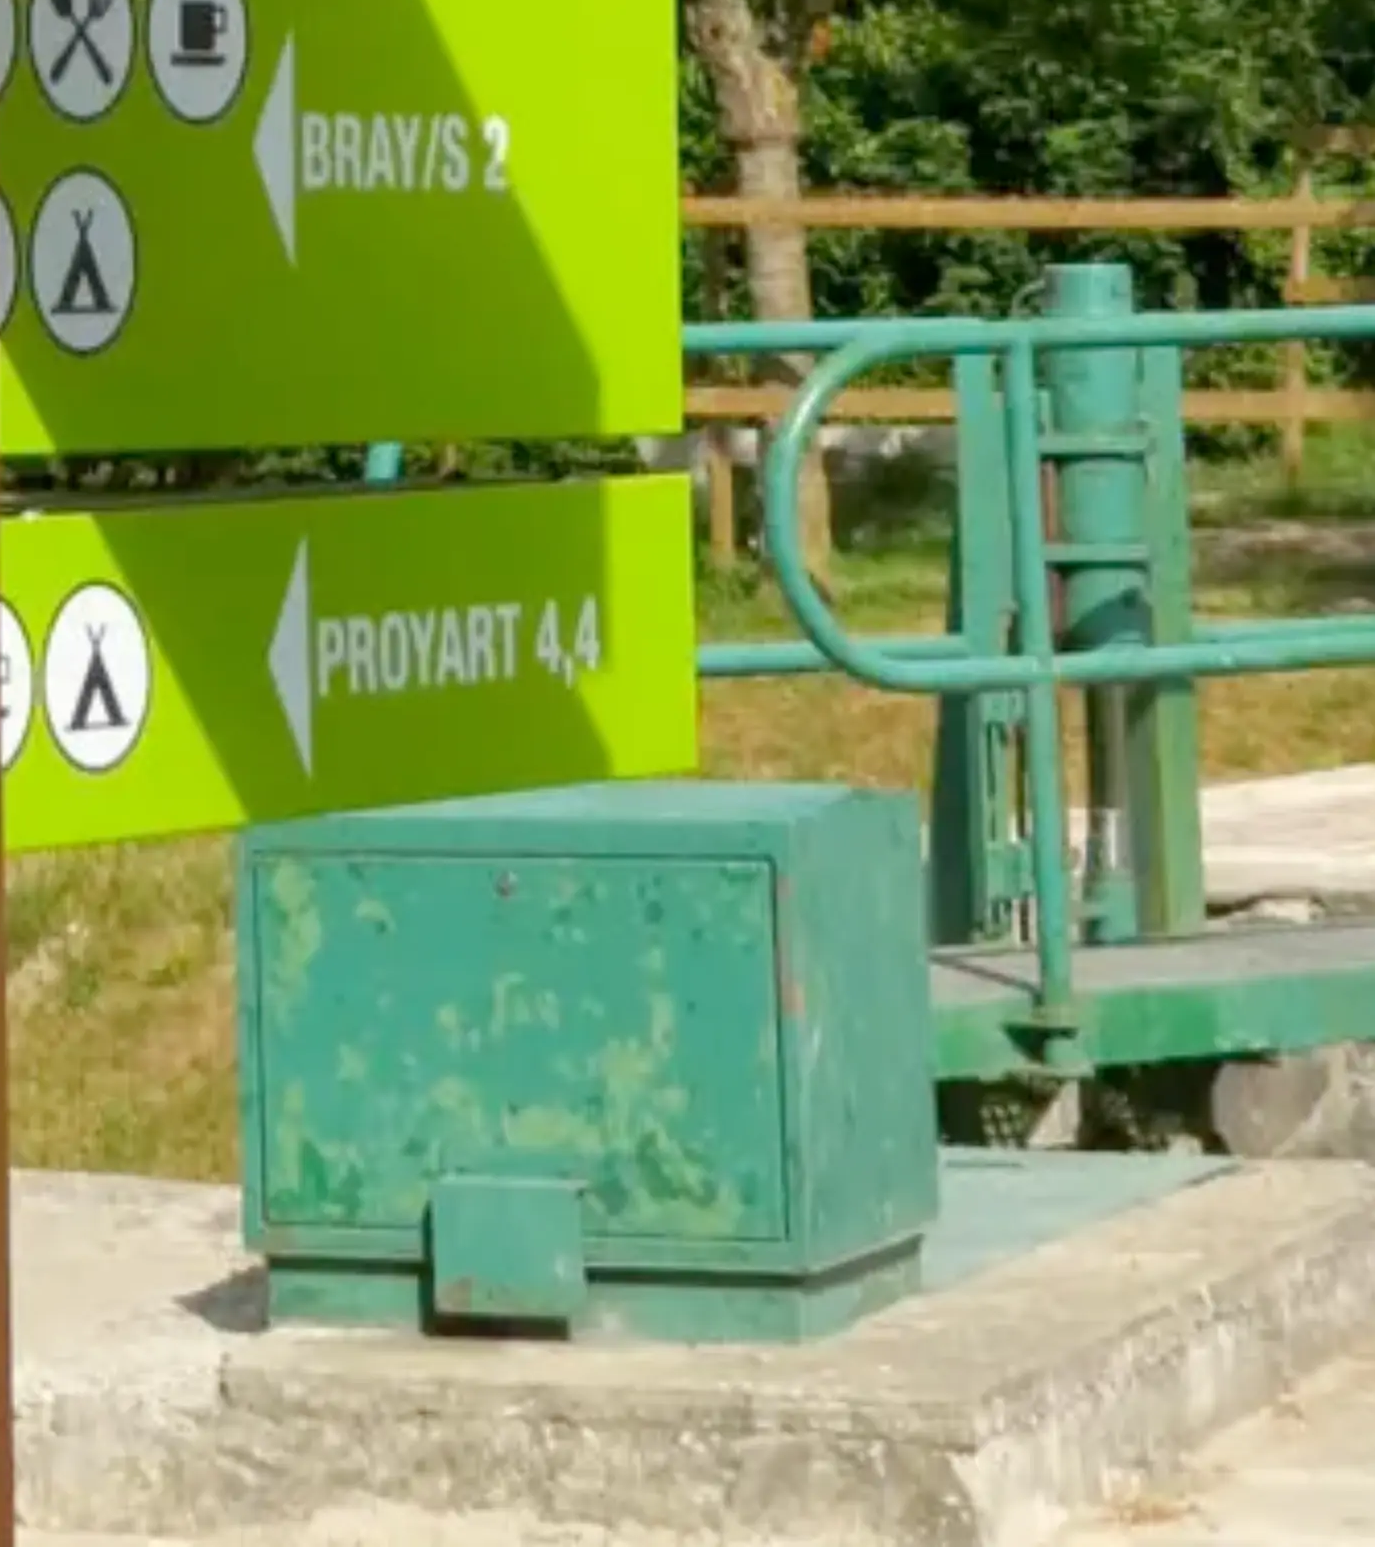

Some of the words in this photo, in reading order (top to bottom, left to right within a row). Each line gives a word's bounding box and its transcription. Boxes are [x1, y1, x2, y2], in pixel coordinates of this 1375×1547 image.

[302, 111, 468, 191] BRAY/S
[483, 114, 510, 191] 2
[317, 601, 520, 697] PROYART
[536, 594, 601, 684] 4,4
